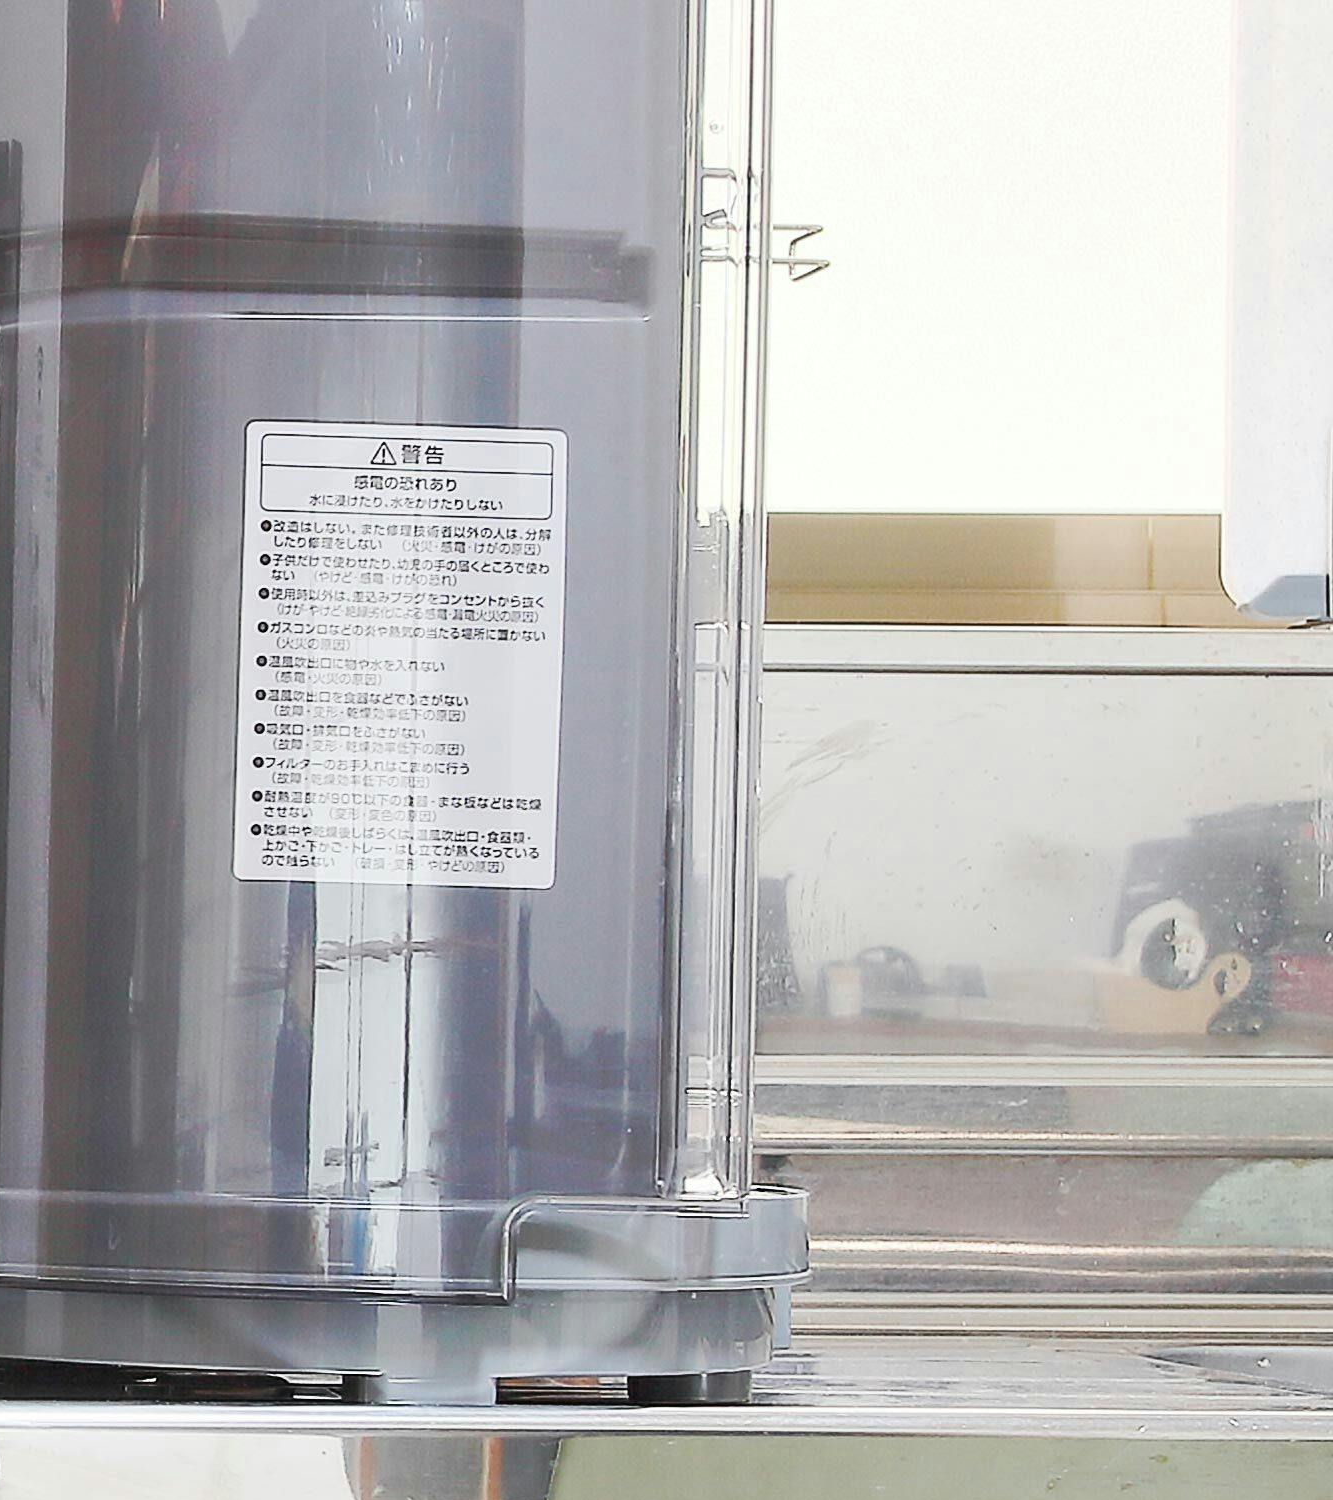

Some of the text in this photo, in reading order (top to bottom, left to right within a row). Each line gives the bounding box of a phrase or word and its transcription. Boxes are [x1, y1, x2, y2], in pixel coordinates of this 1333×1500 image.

[401, 444, 445, 465] 警告
[354, 475, 457, 492] 感電の恐れあり
[272, 569, 295, 581] ない
[263, 806, 313, 818] させない
